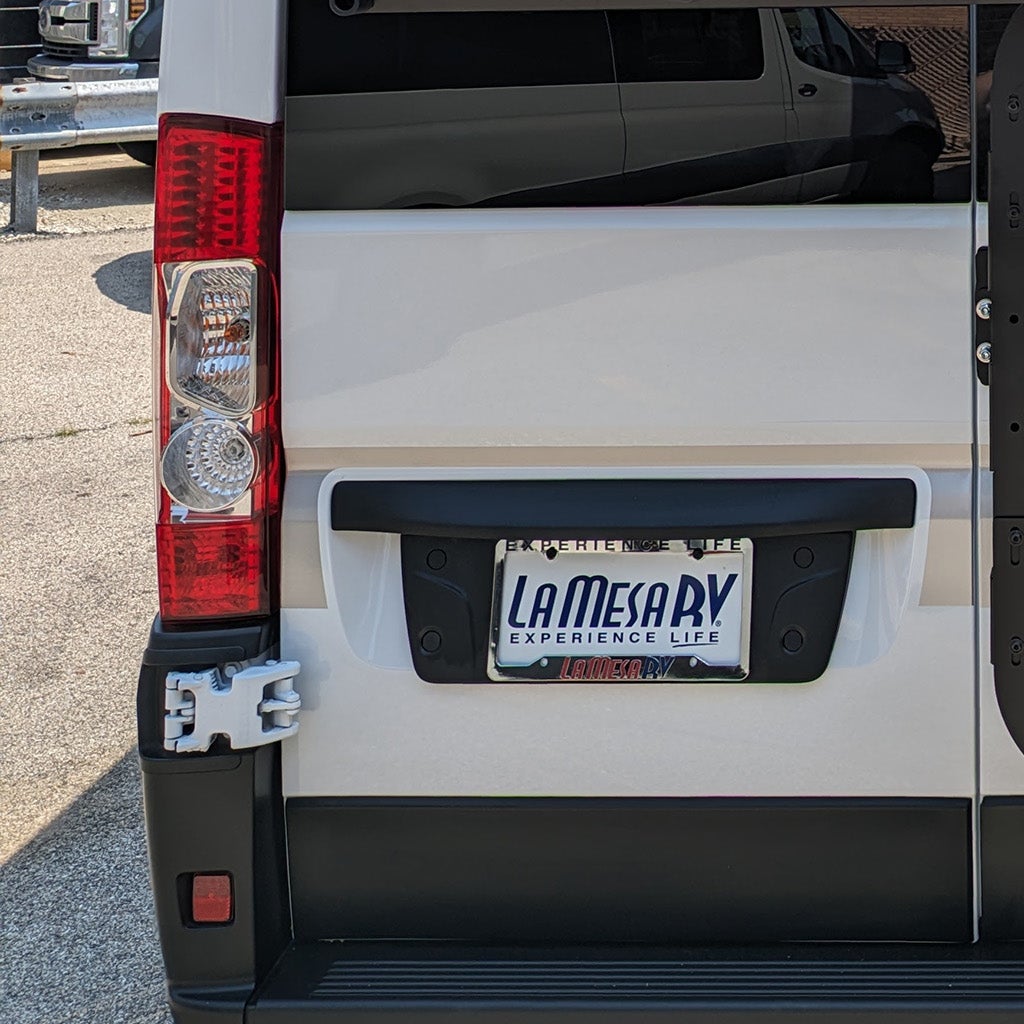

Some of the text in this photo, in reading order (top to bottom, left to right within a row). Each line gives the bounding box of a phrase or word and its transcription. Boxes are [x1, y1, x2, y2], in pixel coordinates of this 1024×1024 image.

[505, 538, 742, 552] EXPERIENCE LIFE
[510, 631, 720, 645] EXPERIENCE LIFE
